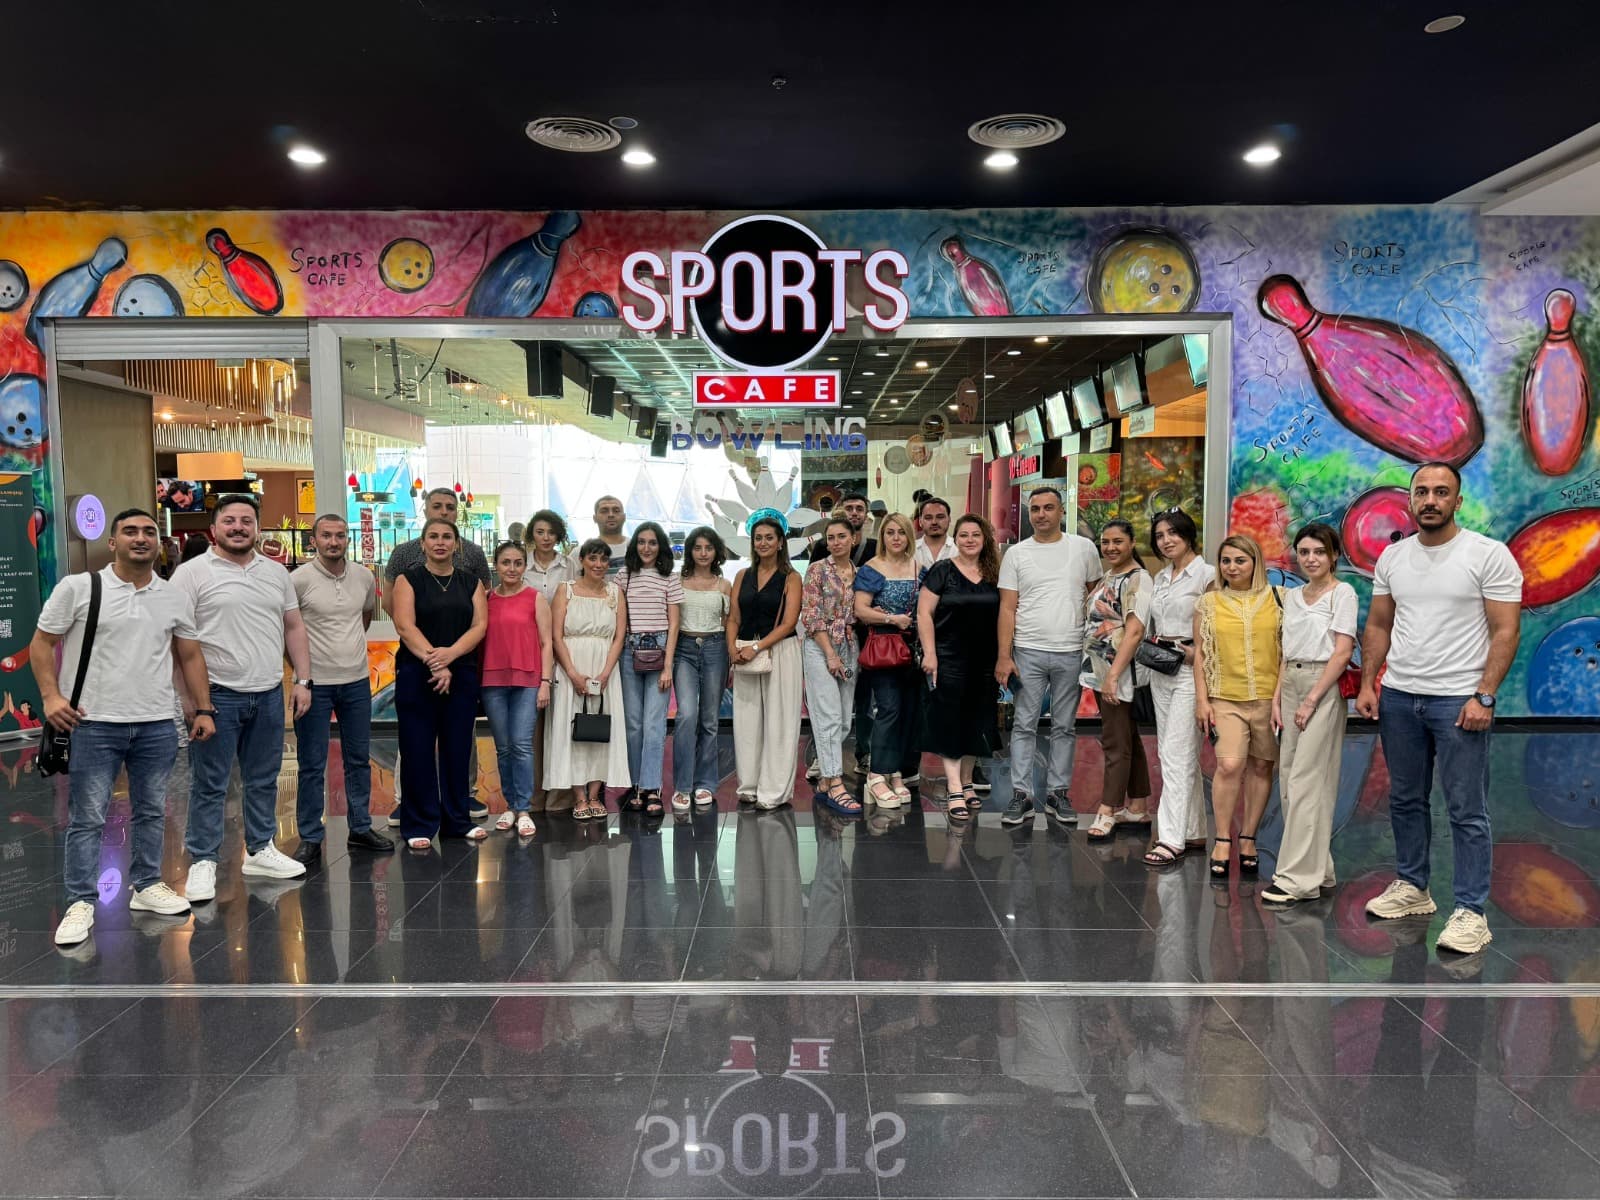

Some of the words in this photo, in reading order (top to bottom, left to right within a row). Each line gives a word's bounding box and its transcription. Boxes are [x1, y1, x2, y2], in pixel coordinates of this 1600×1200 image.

[288, 247, 363, 273] SPORTS
[1334, 240, 1406, 263] SPORTS
[307, 273, 346, 286] CAFE
[1026, 263, 1057, 275] CAFE
[1352, 263, 1401, 276] CAFE
[621, 249, 910, 333] SPORTS
[703, 378, 830, 401] CAFE
[670, 416, 868, 451] BOWLING
[1252, 408, 1315, 464] SPORTS
[1281, 426, 1322, 465] CAFE
[1560, 479, 1600, 500] SPORTS
[1572, 491, 1600, 505] CAFE
